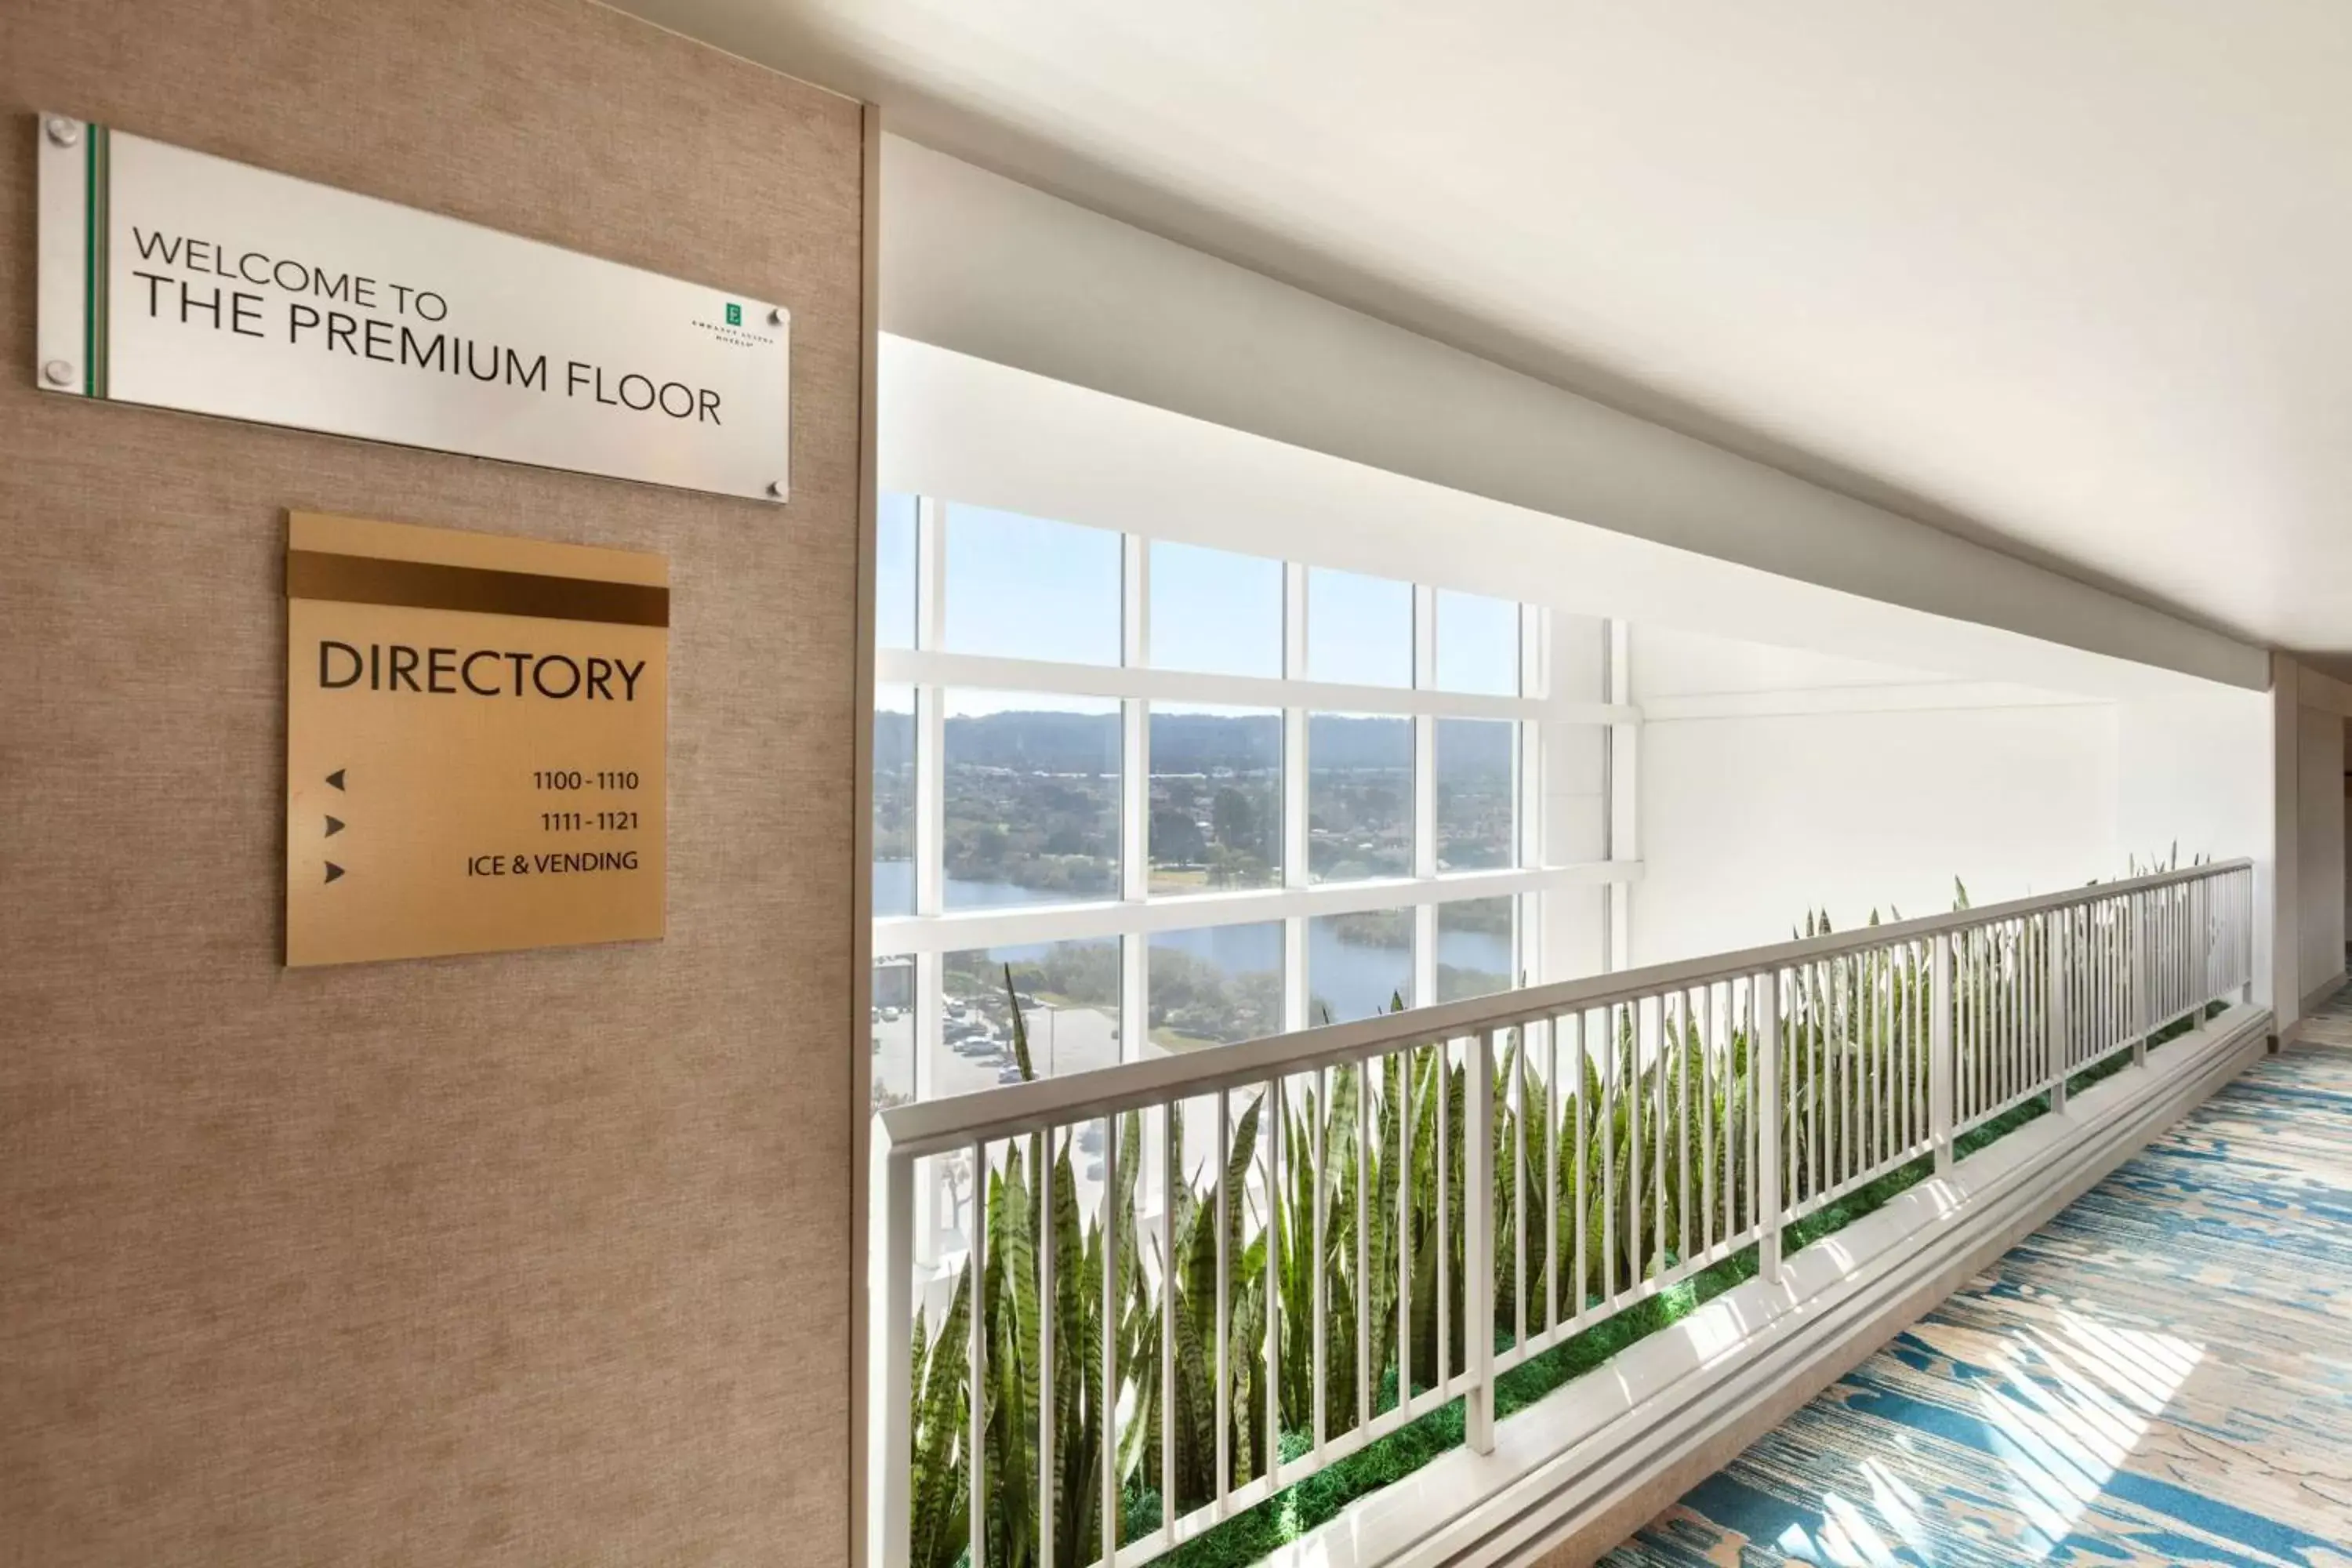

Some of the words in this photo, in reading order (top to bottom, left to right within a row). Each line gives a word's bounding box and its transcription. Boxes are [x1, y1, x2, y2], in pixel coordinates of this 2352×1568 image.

[132, 226, 377, 308] WELCOME
[388, 284, 448, 322] TO
[132, 270, 264, 338] THE
[290, 303, 546, 392] PREMIUM
[568, 361, 721, 426] FLOOR
[320, 641, 646, 702] DIRECTORY
[468, 855, 506, 877] ICE
[511, 854, 531, 875] &
[532, 850, 638, 874] VENDING
